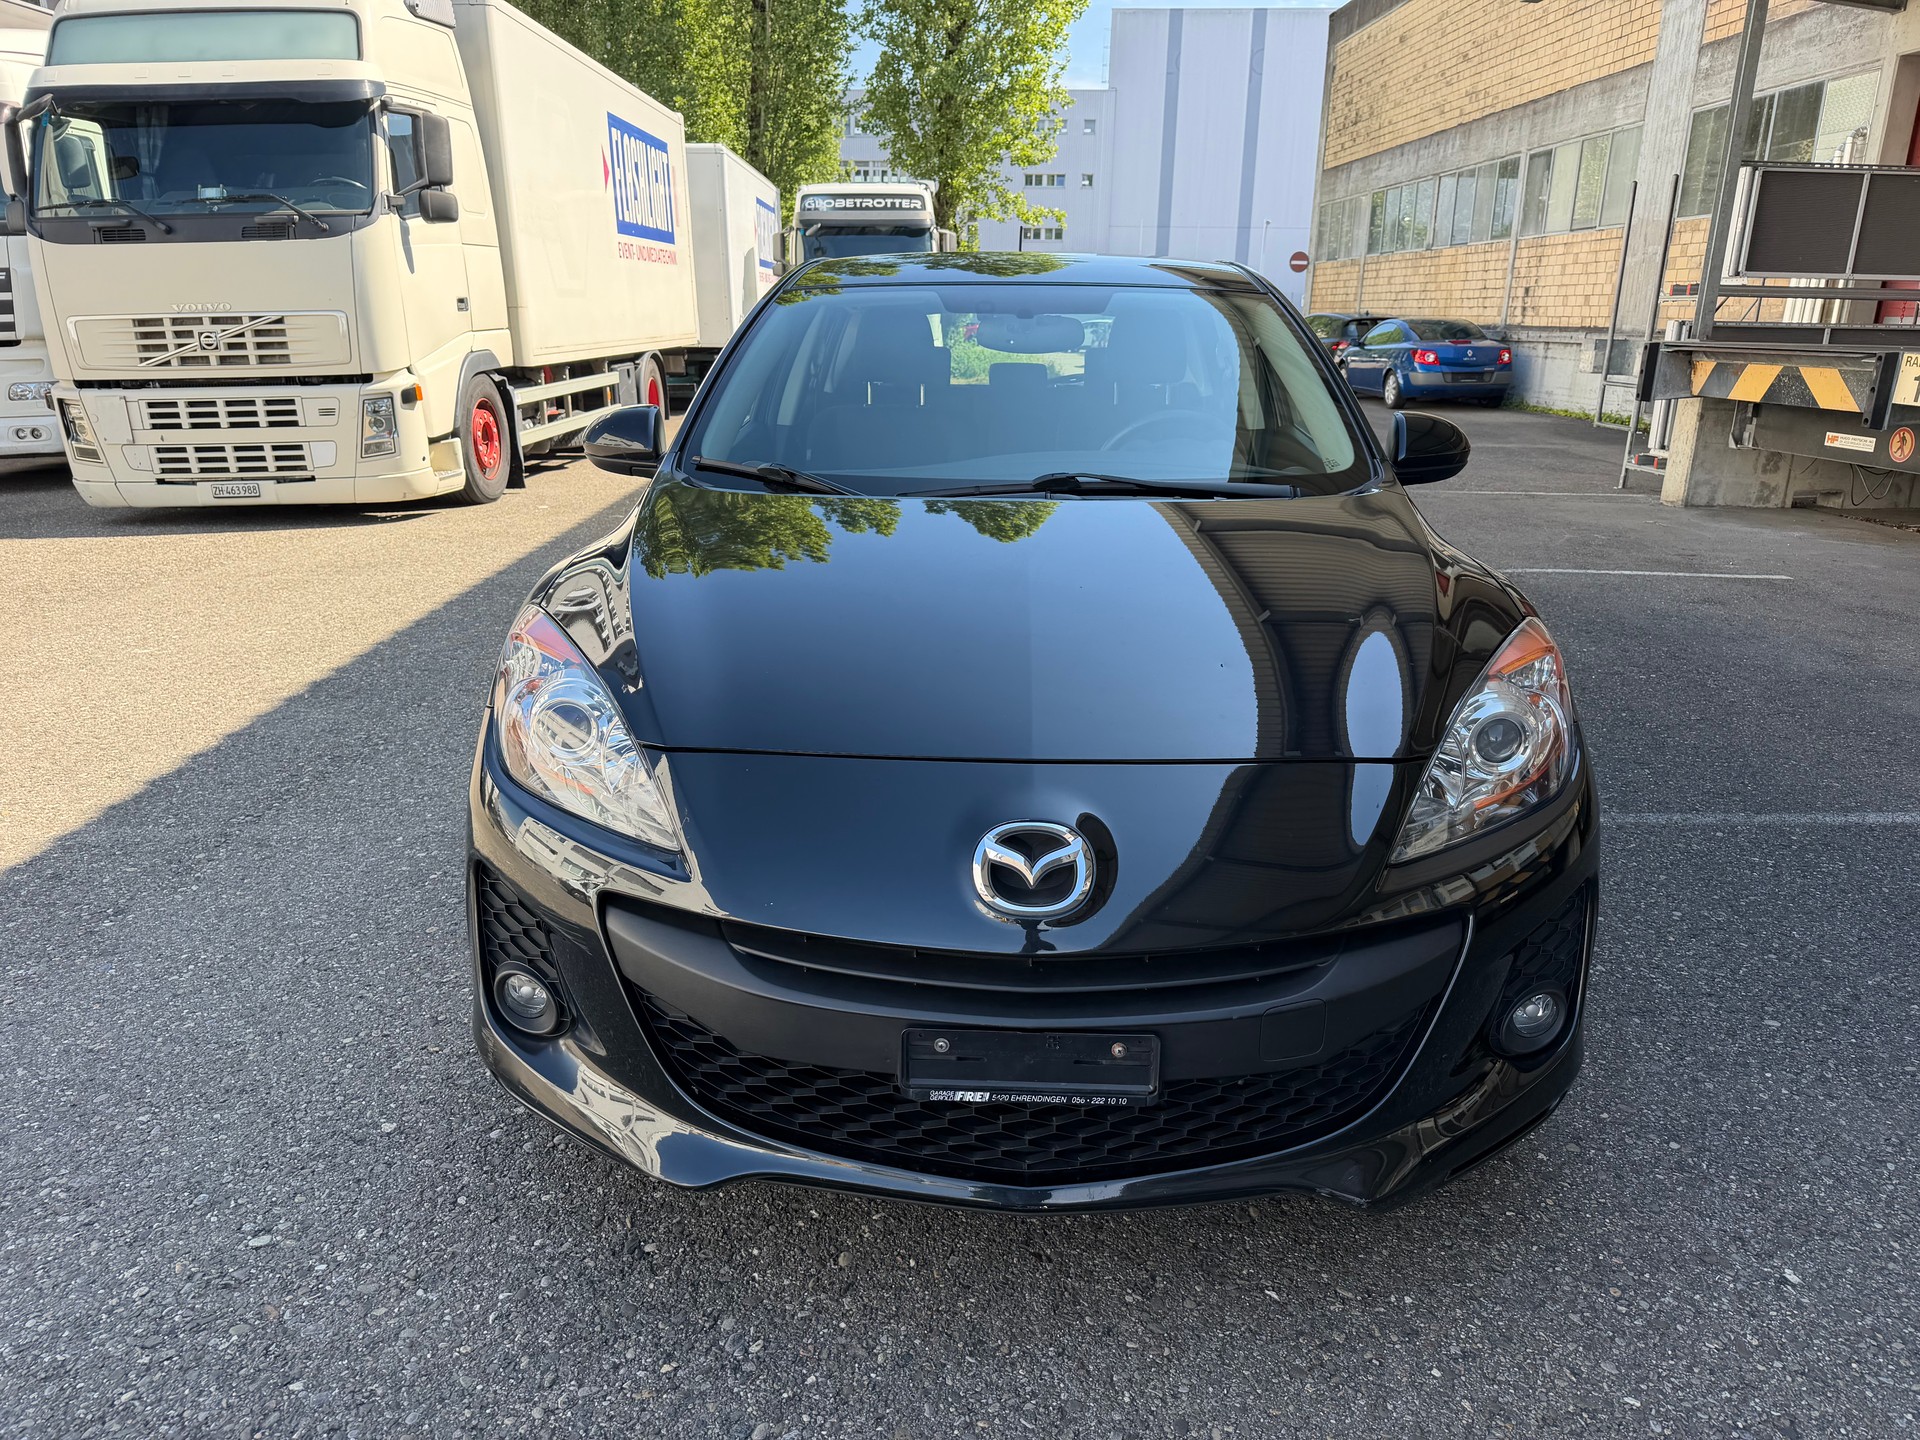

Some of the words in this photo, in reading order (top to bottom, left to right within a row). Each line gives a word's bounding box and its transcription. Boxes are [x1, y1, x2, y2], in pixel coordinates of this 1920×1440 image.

[611, 127, 672, 233] FLASHLIGHT
[805, 198, 922, 209] GLOBETROTTER
[170, 302, 232, 313] VOLVO
[1905, 355, 1920, 367] RA
[1010, 1095, 1067, 1103] EHRENDINGEN
[1071, 1096, 1085, 1104] 056
[1091, 1097, 1106, 1105] 222
